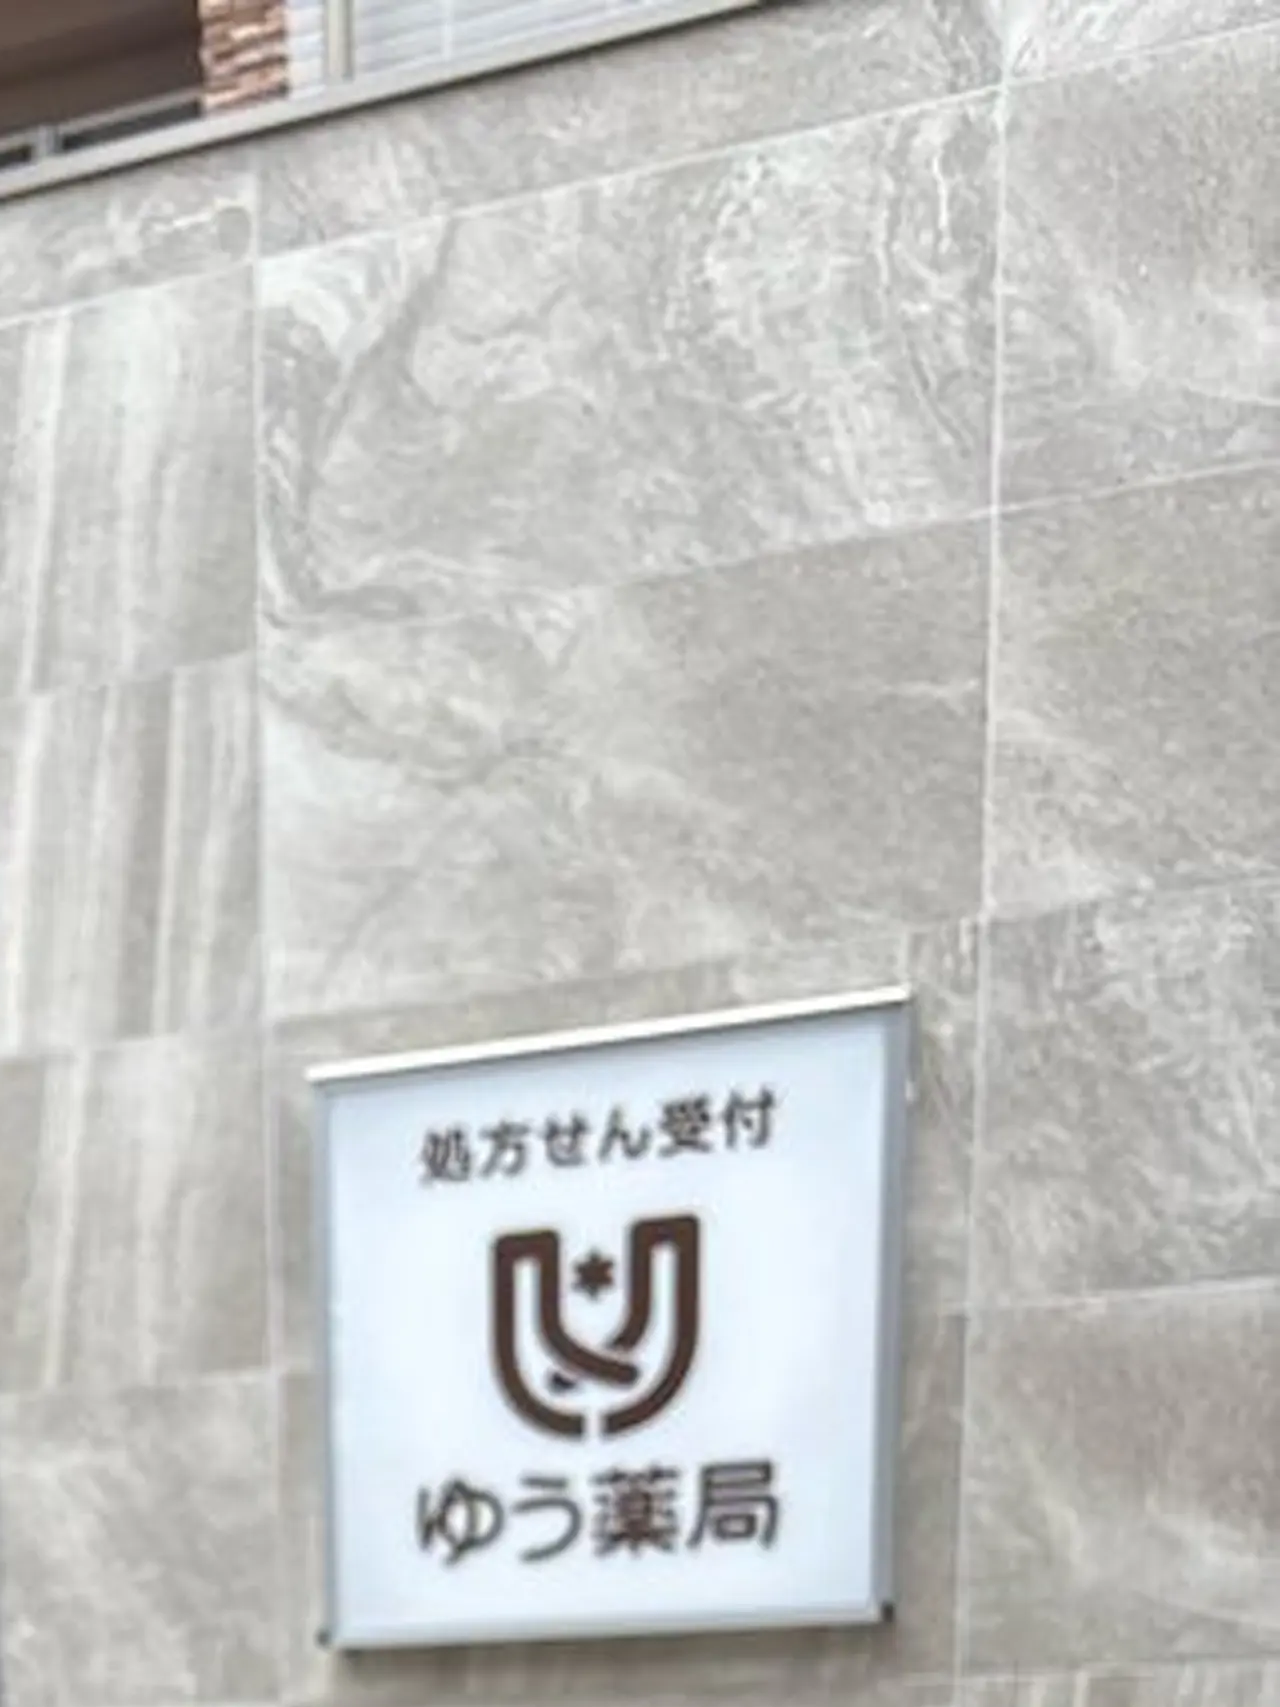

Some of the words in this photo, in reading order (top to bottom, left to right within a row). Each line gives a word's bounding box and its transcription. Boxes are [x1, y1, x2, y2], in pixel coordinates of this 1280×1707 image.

[420, 1088, 775, 1184] 処方せん受付
[416, 1460, 778, 1564] ゆう薬局
